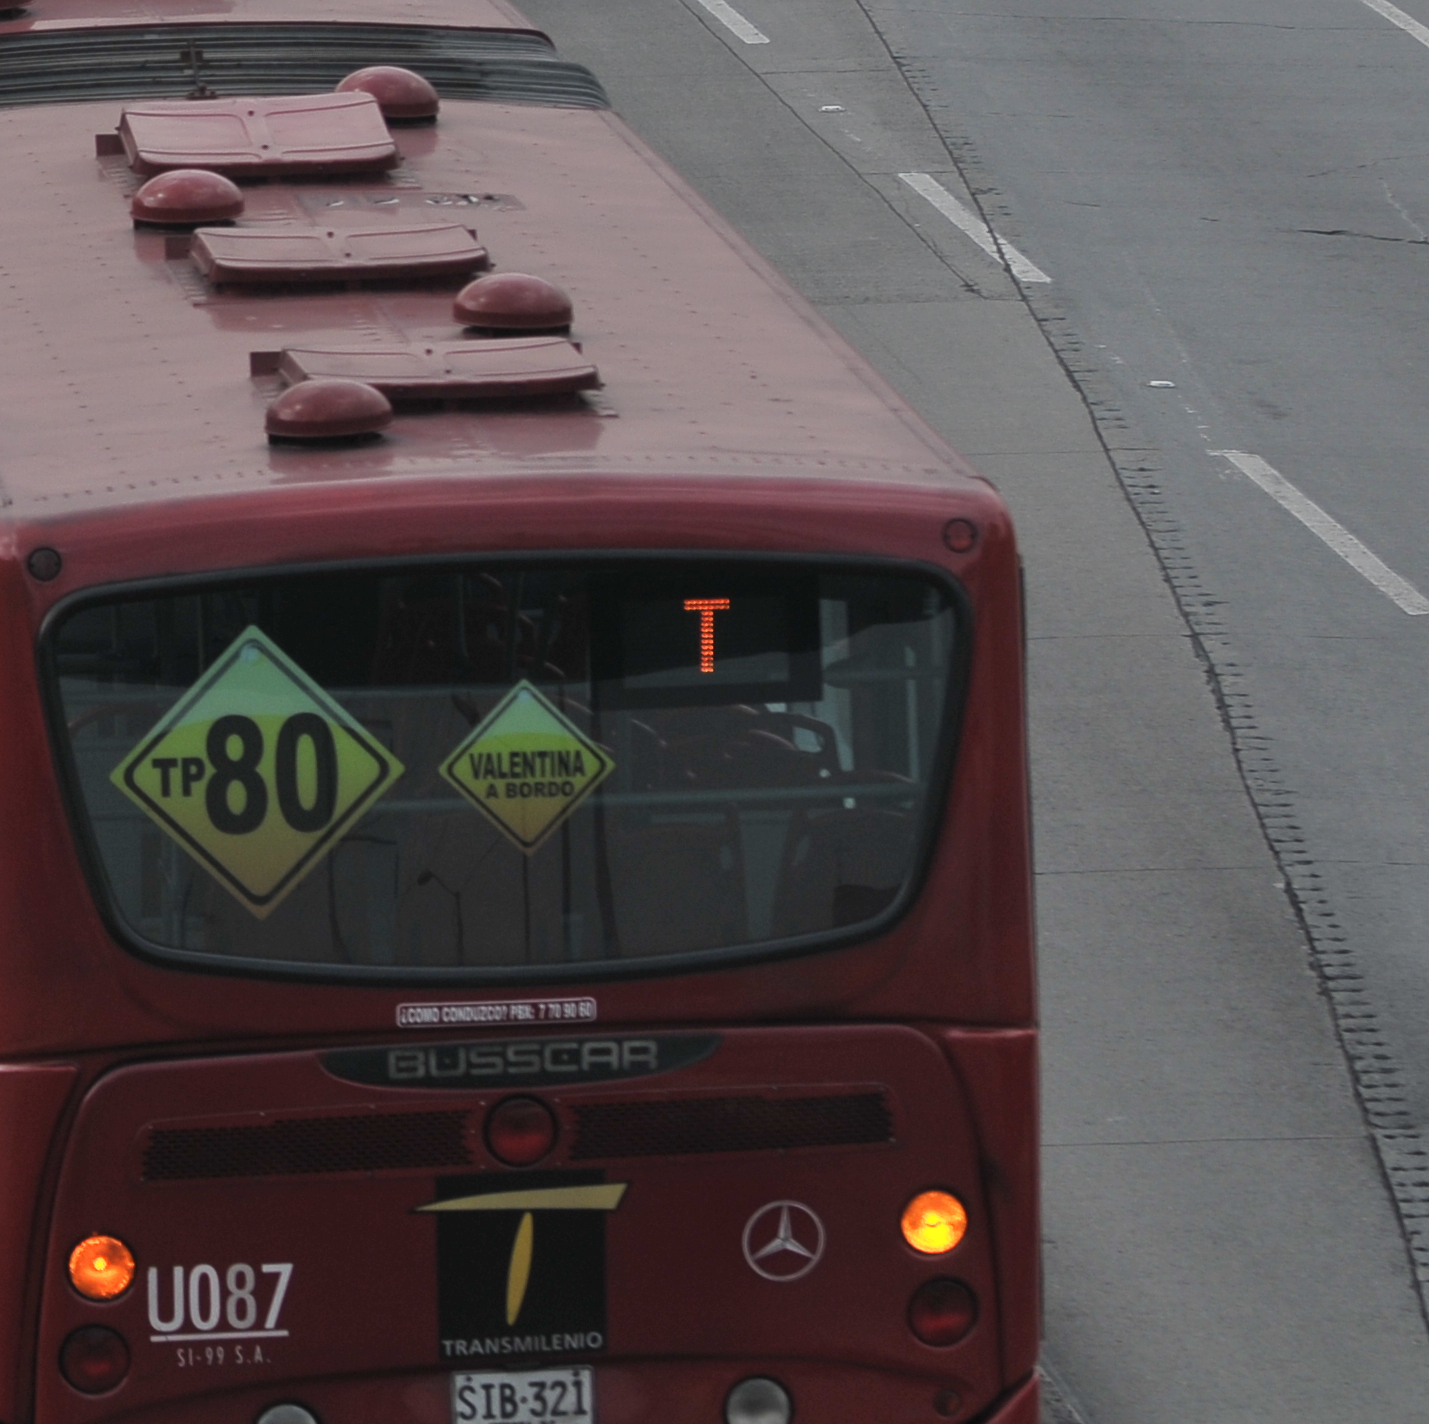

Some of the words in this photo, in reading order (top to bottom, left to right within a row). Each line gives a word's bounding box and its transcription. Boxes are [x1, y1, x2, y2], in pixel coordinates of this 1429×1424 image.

[683, 597, 730, 674] T
[151, 756, 205, 800] TP
[205, 711, 337, 835] 80
[468, 749, 585, 782] VALENTINA
[485, 782, 501, 800] A
[506, 777, 575, 799] BORDO
[441, 1005, 508, 1023] CONDUZCO?
[537, 1003, 546, 1019] 7
[387, 1039, 658, 1079] BUSSCAR
[147, 1262, 294, 1332] U087
[176, 1345, 224, 1367] SI-99
[234, 1344, 272, 1364] S.A.
[442, 1331, 603, 1357] TRANSMILENIO
